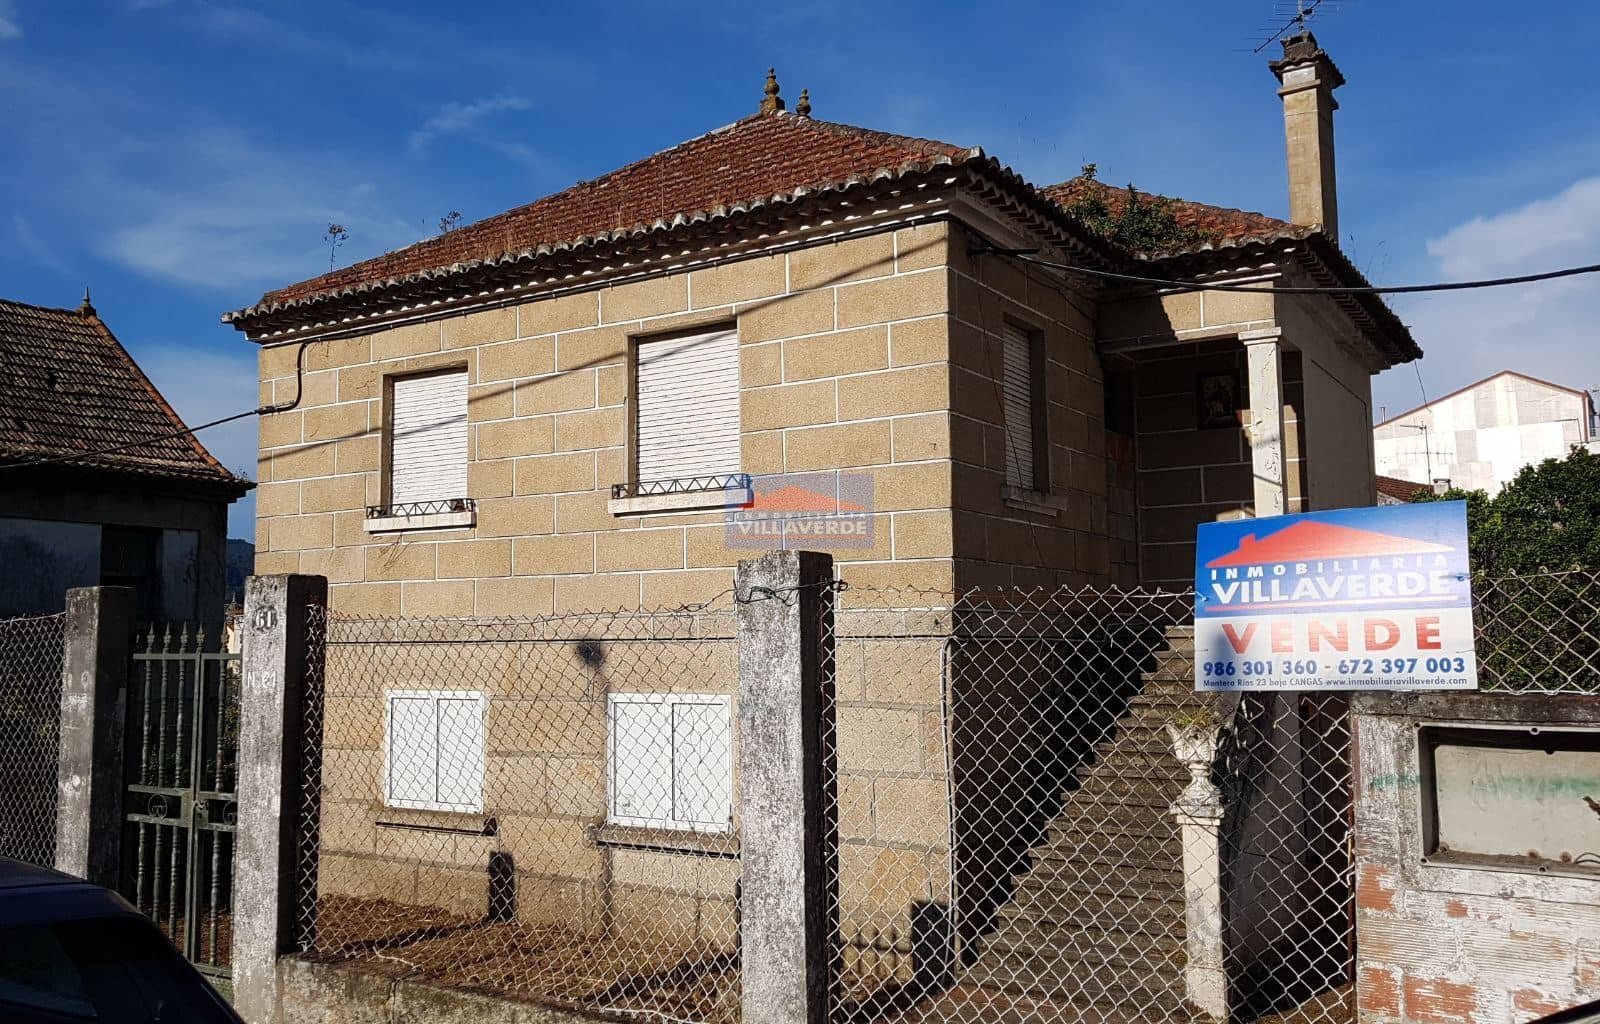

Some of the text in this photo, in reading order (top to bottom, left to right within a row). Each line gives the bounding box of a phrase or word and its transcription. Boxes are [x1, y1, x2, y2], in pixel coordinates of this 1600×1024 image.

[1211, 554, 1448, 580] INMOBILIARIA
[1211, 570, 1450, 604] VILLAVERDE
[255, 609, 272, 628] 61
[1221, 616, 1442, 655] VENDE
[1203, 661, 1236, 676] 986
[1242, 661, 1273, 675] 301
[1282, 660, 1317, 675] 360
[1338, 659, 1374, 674] 672
[1381, 658, 1418, 674] 397
[1426, 657, 1466, 673] 003
[1256, 678, 1267, 687] 23
[1289, 677, 1324, 686] CANGAS
[1326, 676, 1467, 686] www.inmobiliariavillaverde.com
